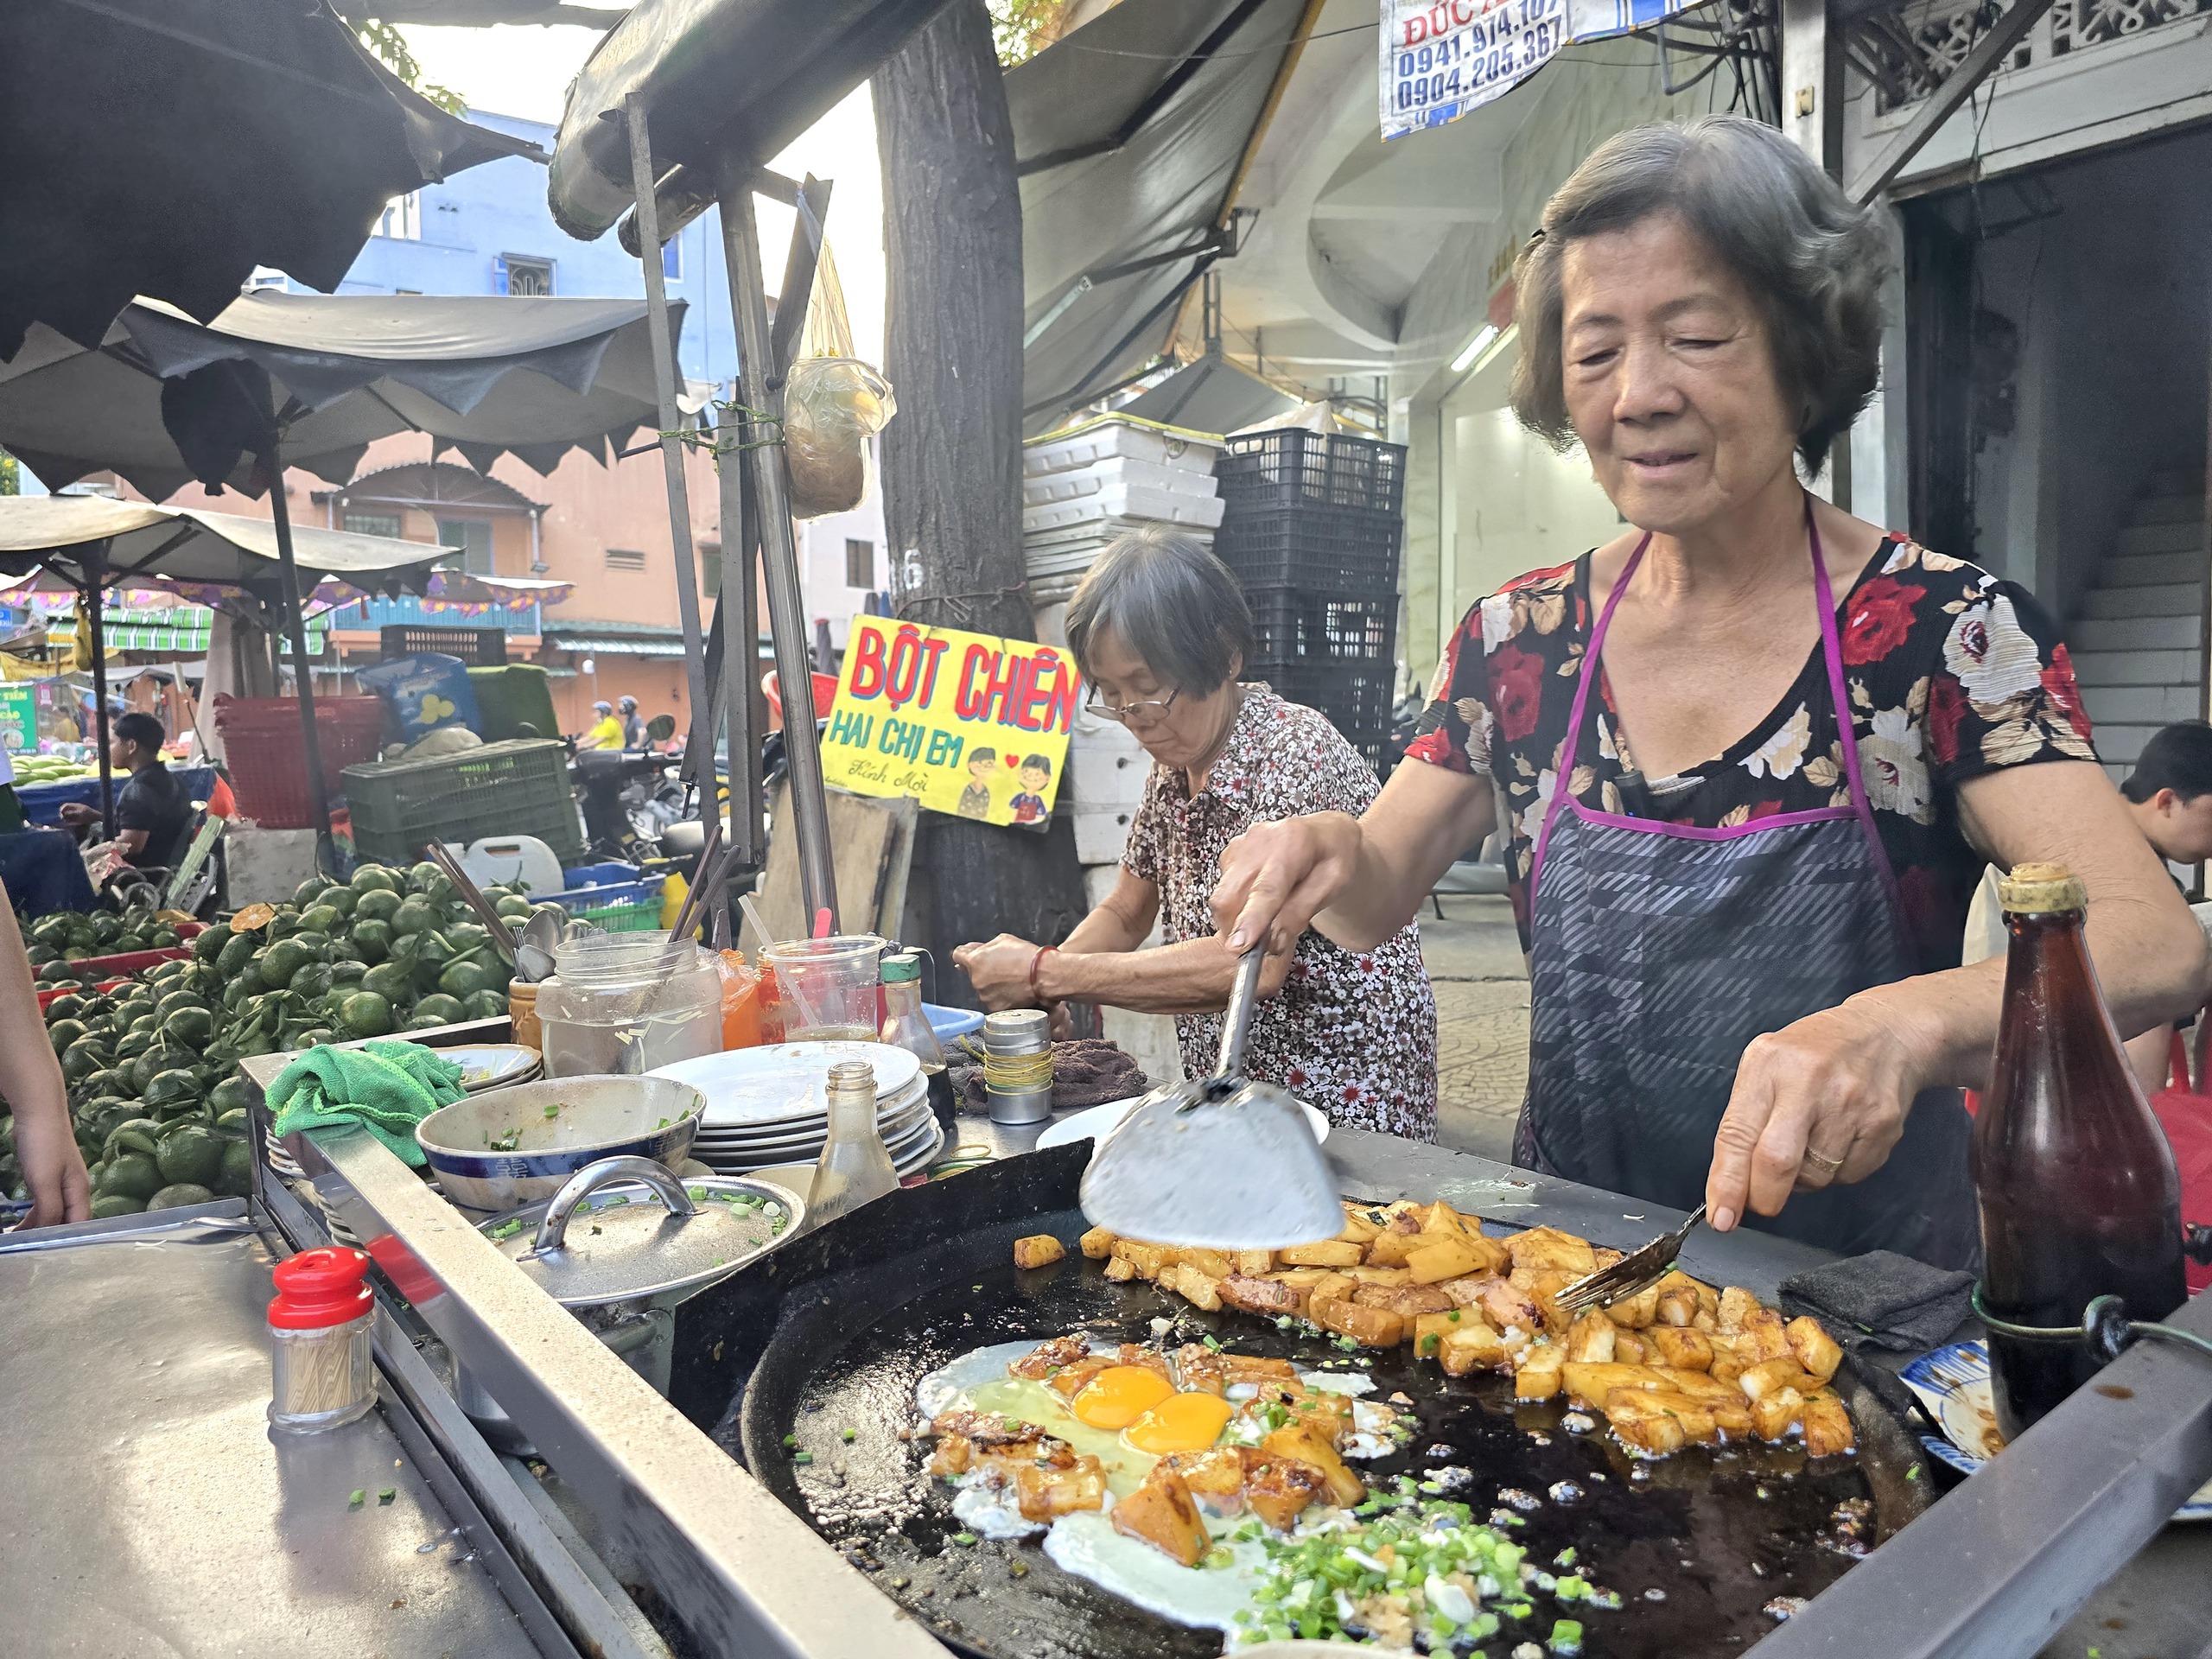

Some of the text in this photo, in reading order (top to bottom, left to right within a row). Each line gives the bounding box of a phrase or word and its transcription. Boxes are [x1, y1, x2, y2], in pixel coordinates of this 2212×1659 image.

[1397, 14, 1562, 110] 0904.205.367
[849, 624, 1083, 734] BỘT CHIÊN
[829, 709, 964, 768] HAI CHỊ EM
[848, 759, 889, 784] Kính
[893, 771, 930, 792] Mời
